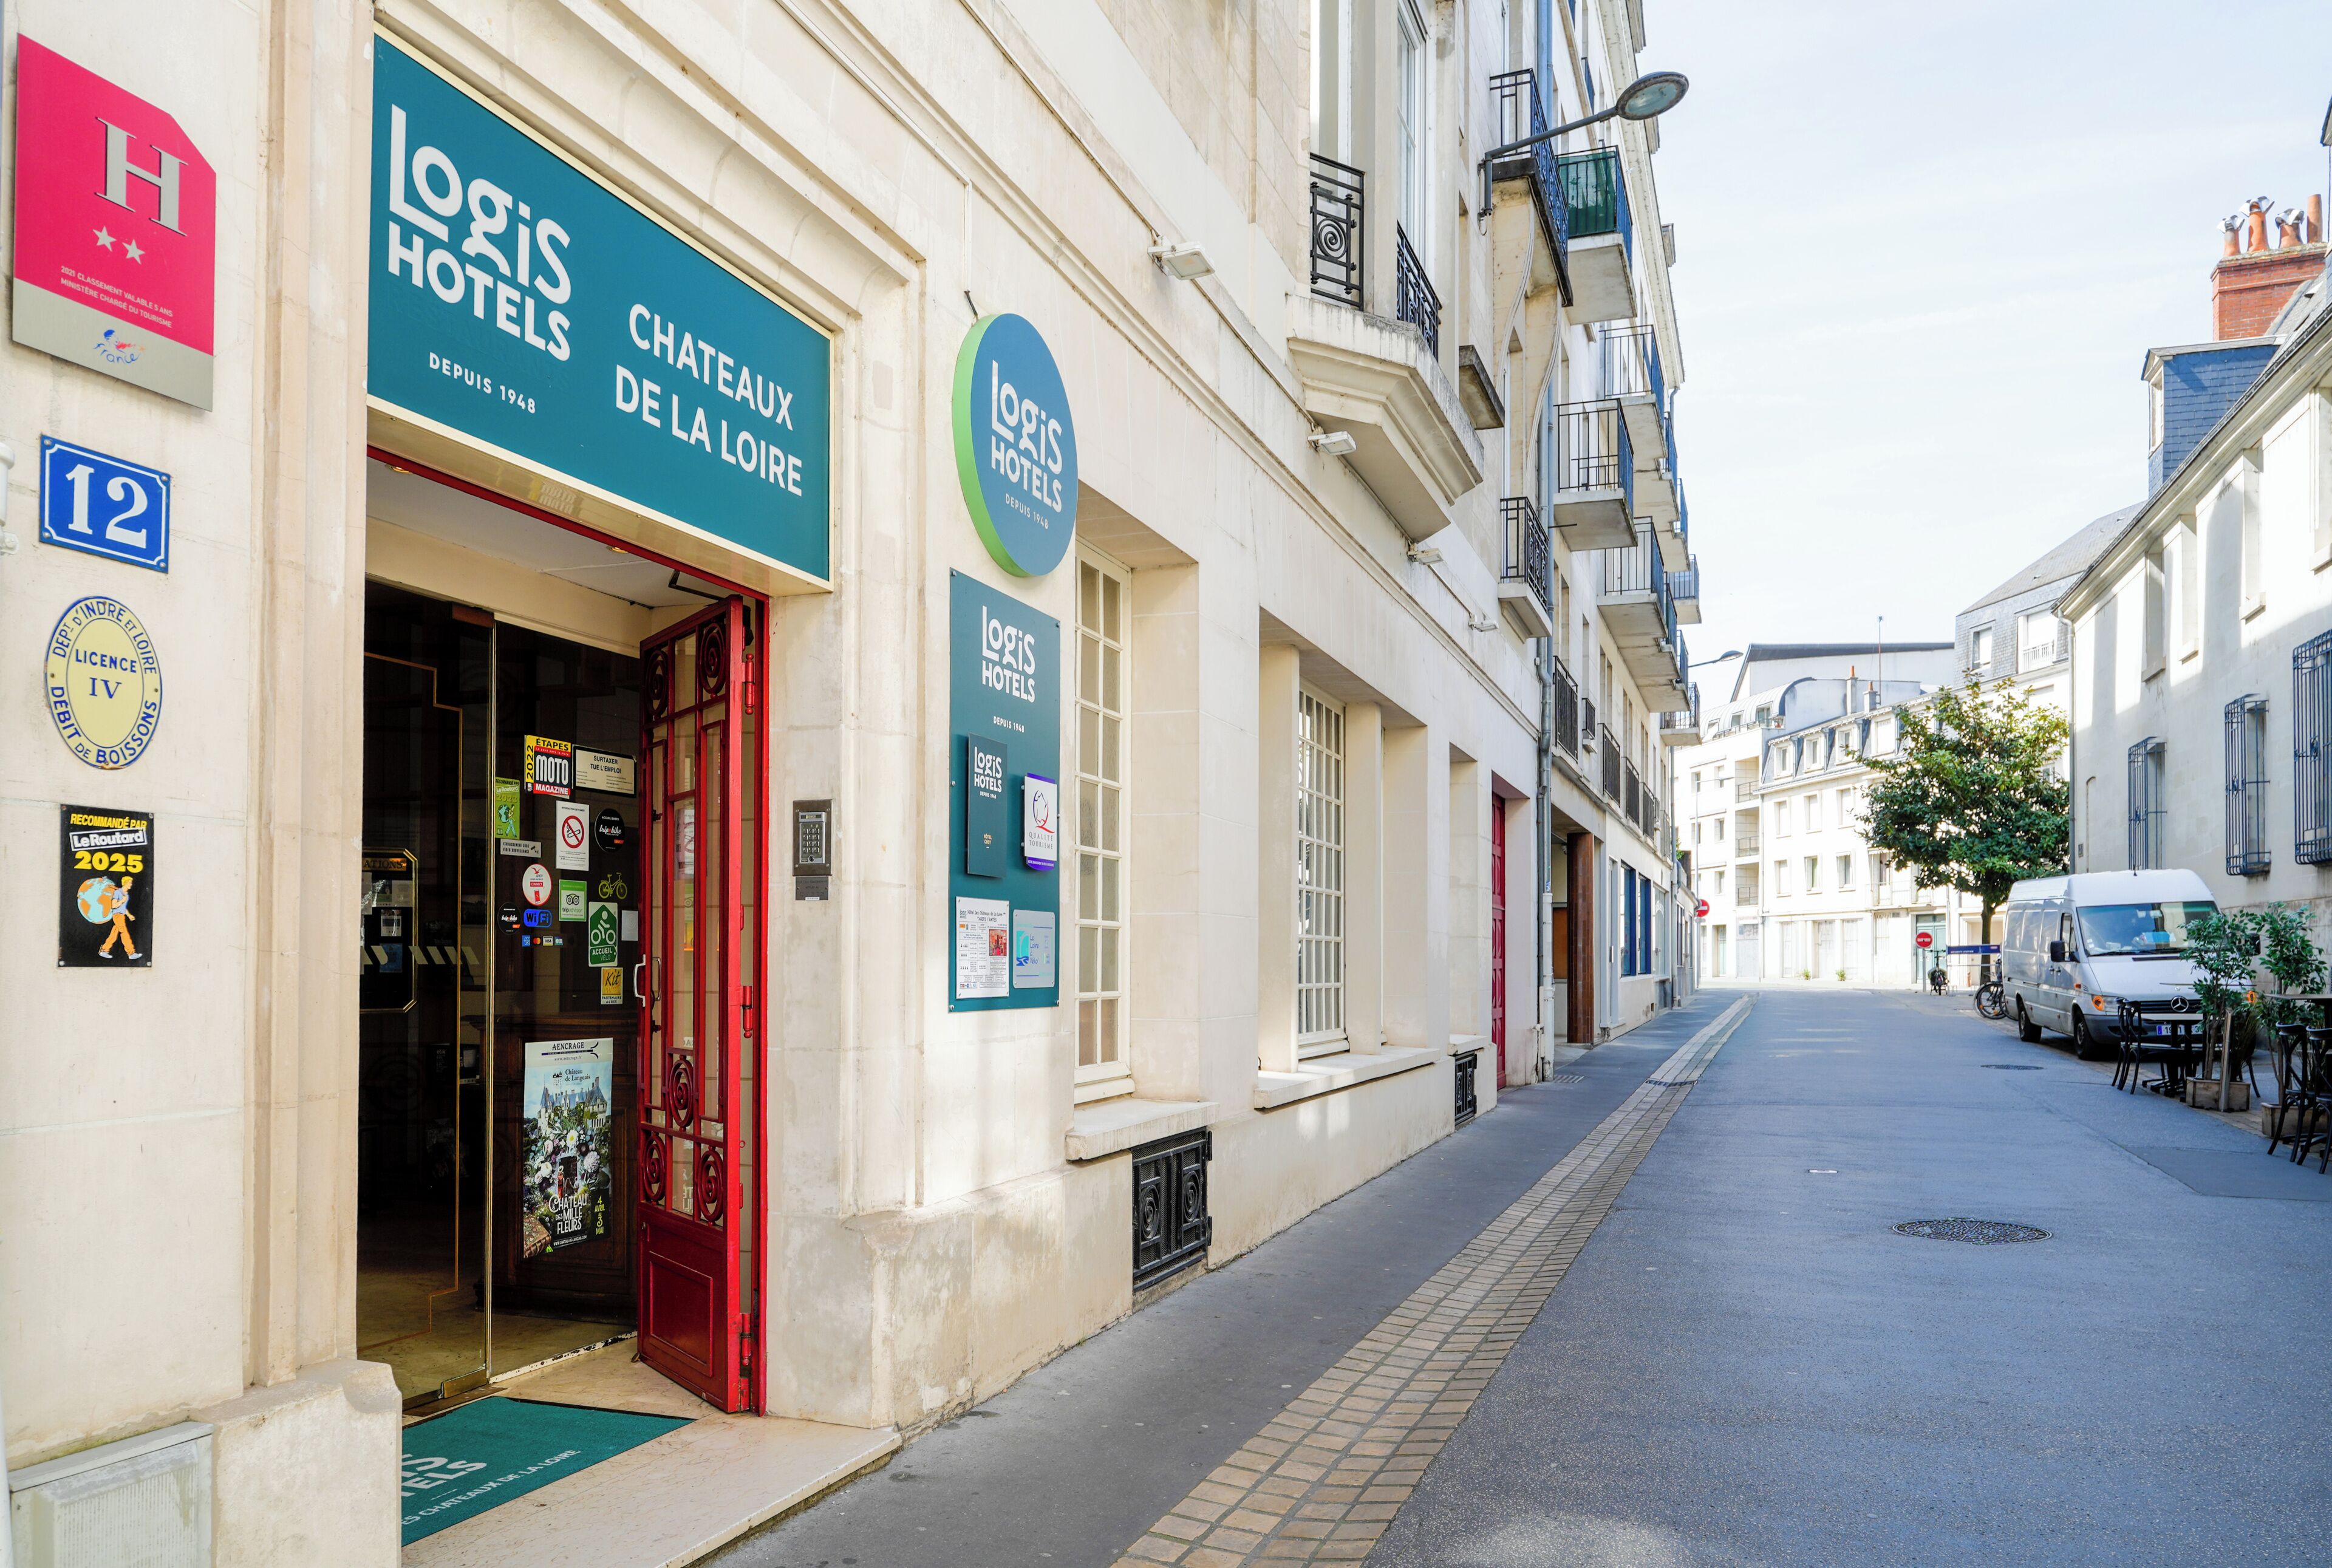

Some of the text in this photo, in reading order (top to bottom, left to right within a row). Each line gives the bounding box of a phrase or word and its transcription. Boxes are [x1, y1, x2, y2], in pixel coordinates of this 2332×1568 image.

[95, 116, 188, 237] H
[77, 273, 122, 296] CLASSEMENT
[124, 291, 153, 310] VALABLE
[154, 302, 159, 311] 5
[160, 306, 173, 318] ANS
[387, 219, 571, 362] HOTELS
[61, 278, 172, 329] MINISTÈRE CHARGÉ DU TOURISME
[629, 304, 794, 432] CHATEAUX
[429, 352, 537, 415] DEPUIS 1948
[615, 364, 802, 497] DE LA LOIRE
[991, 435, 1062, 513] HOTELS
[65, 463, 149, 550] 12
[1006, 493, 1049, 530] DEPUIS 1948
[72, 601, 126, 626] D'INDRE
[124, 619, 137, 632] ET
[132, 632, 157, 675] LOIRE
[75, 649, 137, 673] LICENCE
[89, 677, 122, 699] IV
[982, 660, 1035, 703] HOTELS
[75, 742, 92, 759] DE
[95, 700, 157, 765] BOISSONS
[993, 715, 1025, 733] DEPUIS 1948
[536, 737, 569, 751] ÉTAPES
[536, 754, 569, 785] MOTO
[593, 755, 618, 765] SURTAXER
[601, 765, 621, 774] L'EMPLOI
[536, 783, 568, 795] MAGAZINE
[974, 773, 1002, 793] HOTELS
[70, 813, 147, 830] RECOMMANDÉ PAR
[1029, 839, 1053, 850] TOURISME
[73, 850, 144, 873] 2025
[363, 859, 403, 870] ATIONS
[552, 1041, 585, 1051] AENCRAGE
[549, 1193, 587, 1213] CHÂTEAU
[563, 1206, 582, 1221] MILLE
[595, 1204, 605, 1213] AVRIL
[557, 1218, 582, 1235] FLEURS
[596, 1216, 603, 1227] 3
[596, 1227, 604, 1235] MAI
[419, 1481, 502, 1516] CHATEAUX
[499, 1473, 520, 1482] DE
[518, 1465, 540, 1476] LA
[538, 1449, 581, 1468] LOIRE
